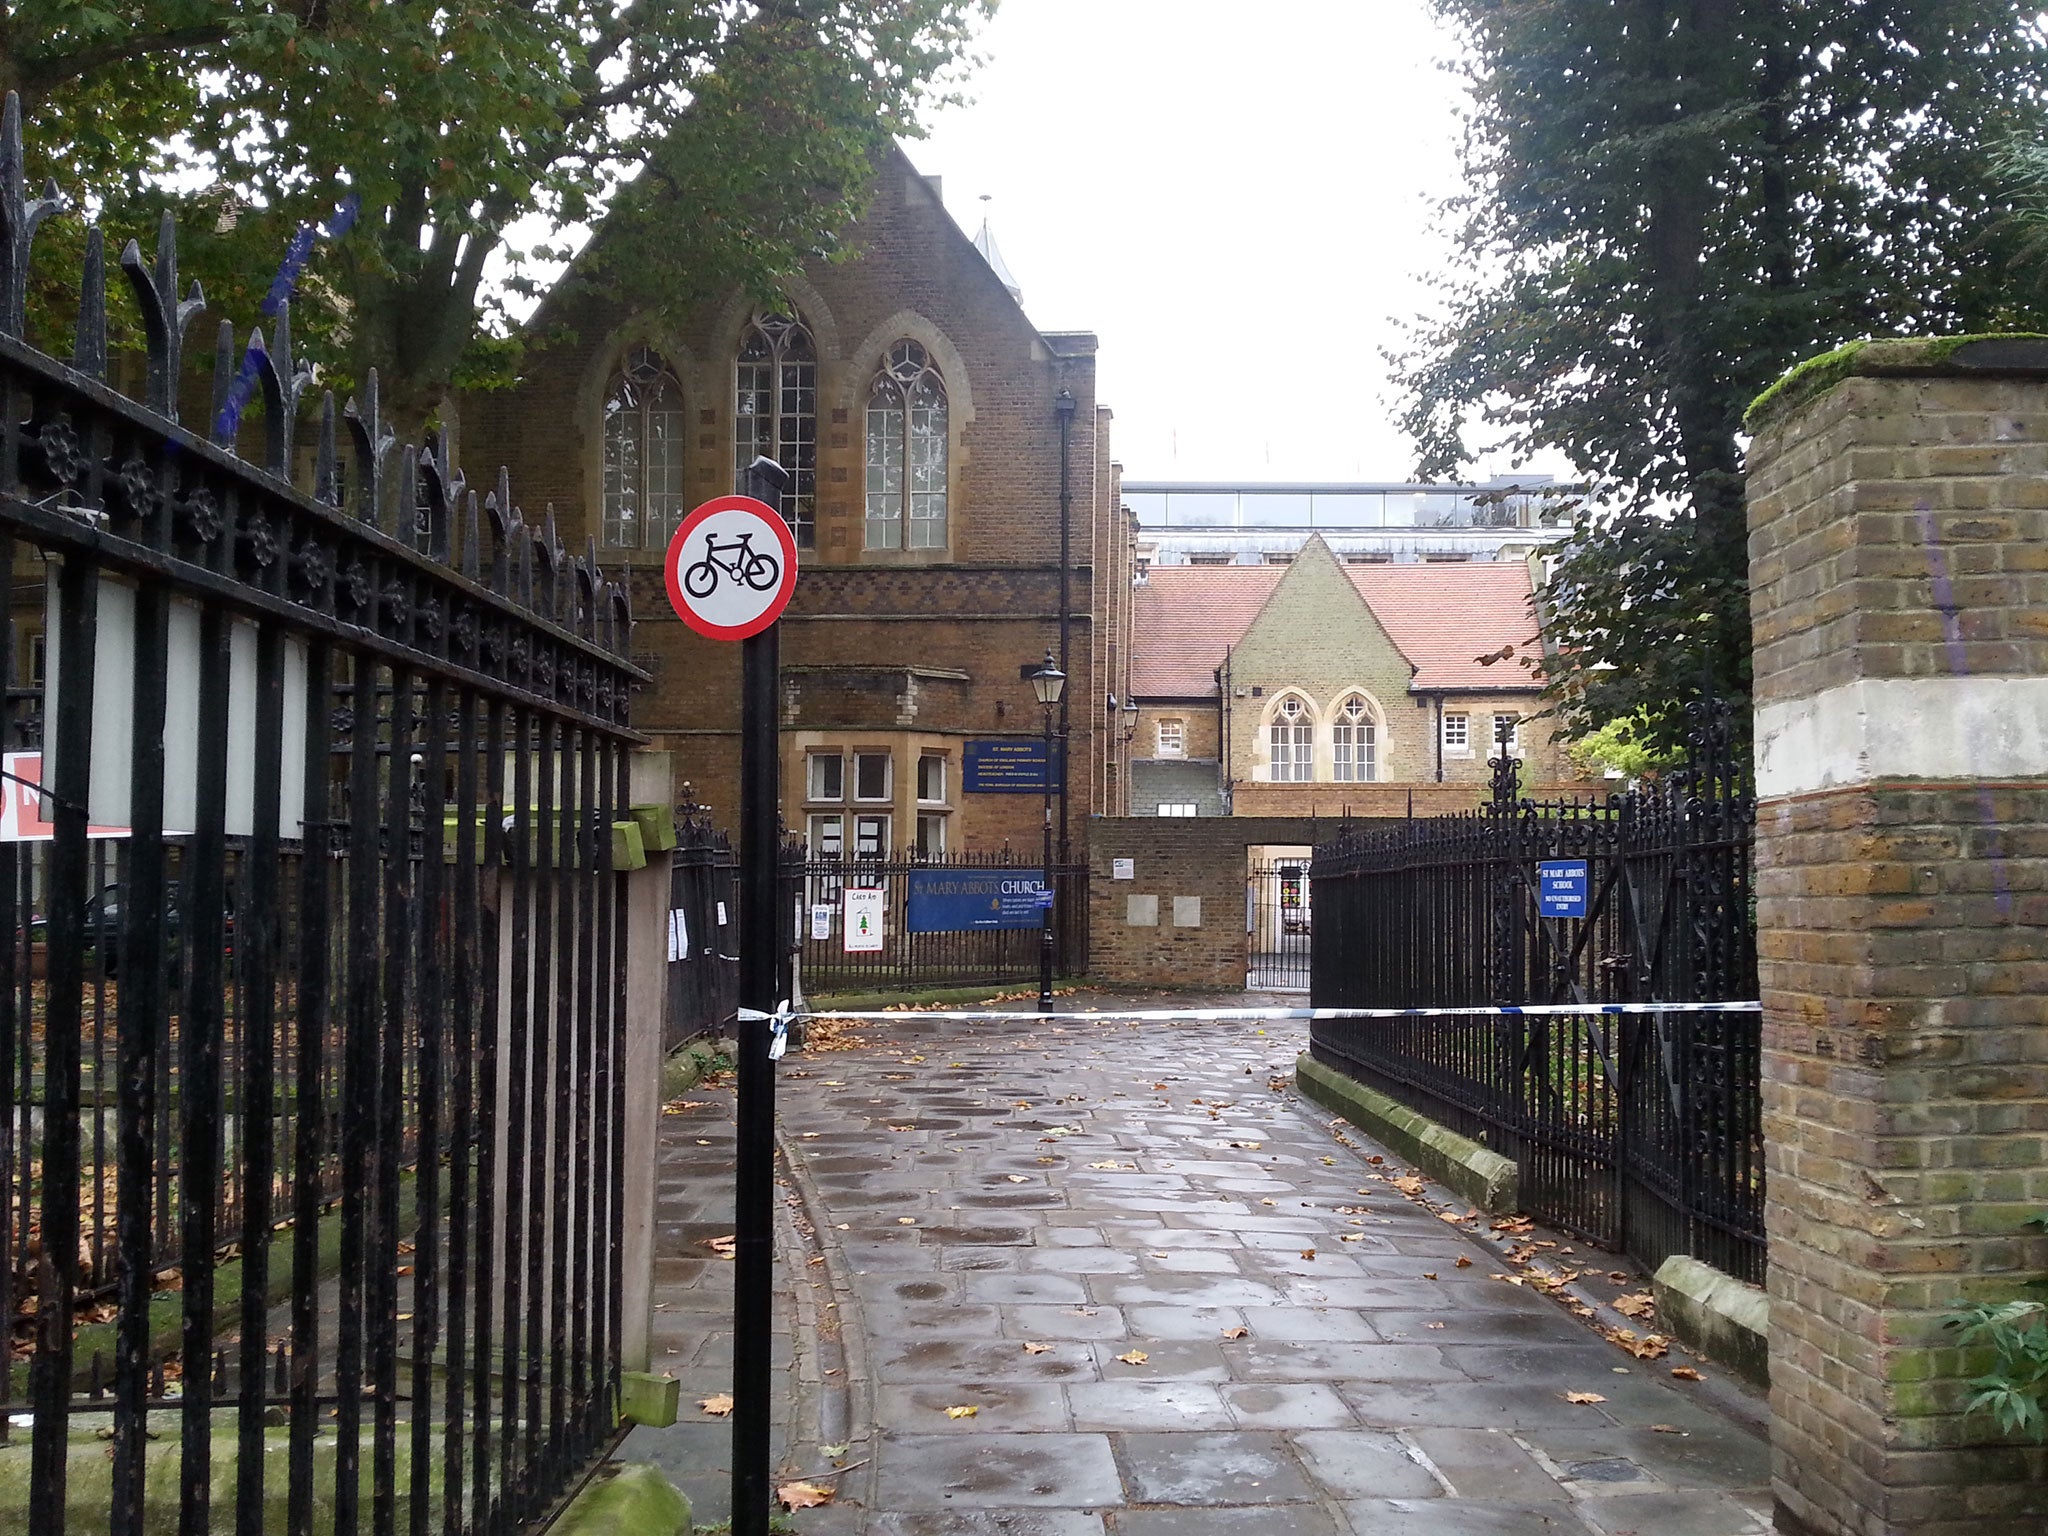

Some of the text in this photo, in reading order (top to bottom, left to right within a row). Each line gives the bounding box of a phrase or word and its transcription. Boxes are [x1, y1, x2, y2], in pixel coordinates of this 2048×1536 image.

[1550, 869, 1564, 878] MARY
[1565, 868, 1585, 878] ABBOTS
[926, 881, 959, 894] MARY
[960, 881, 999, 894] ABBOTS
[1001, 880, 1045, 894] CHURCH
[1552, 880, 1574, 889] SCHOOL
